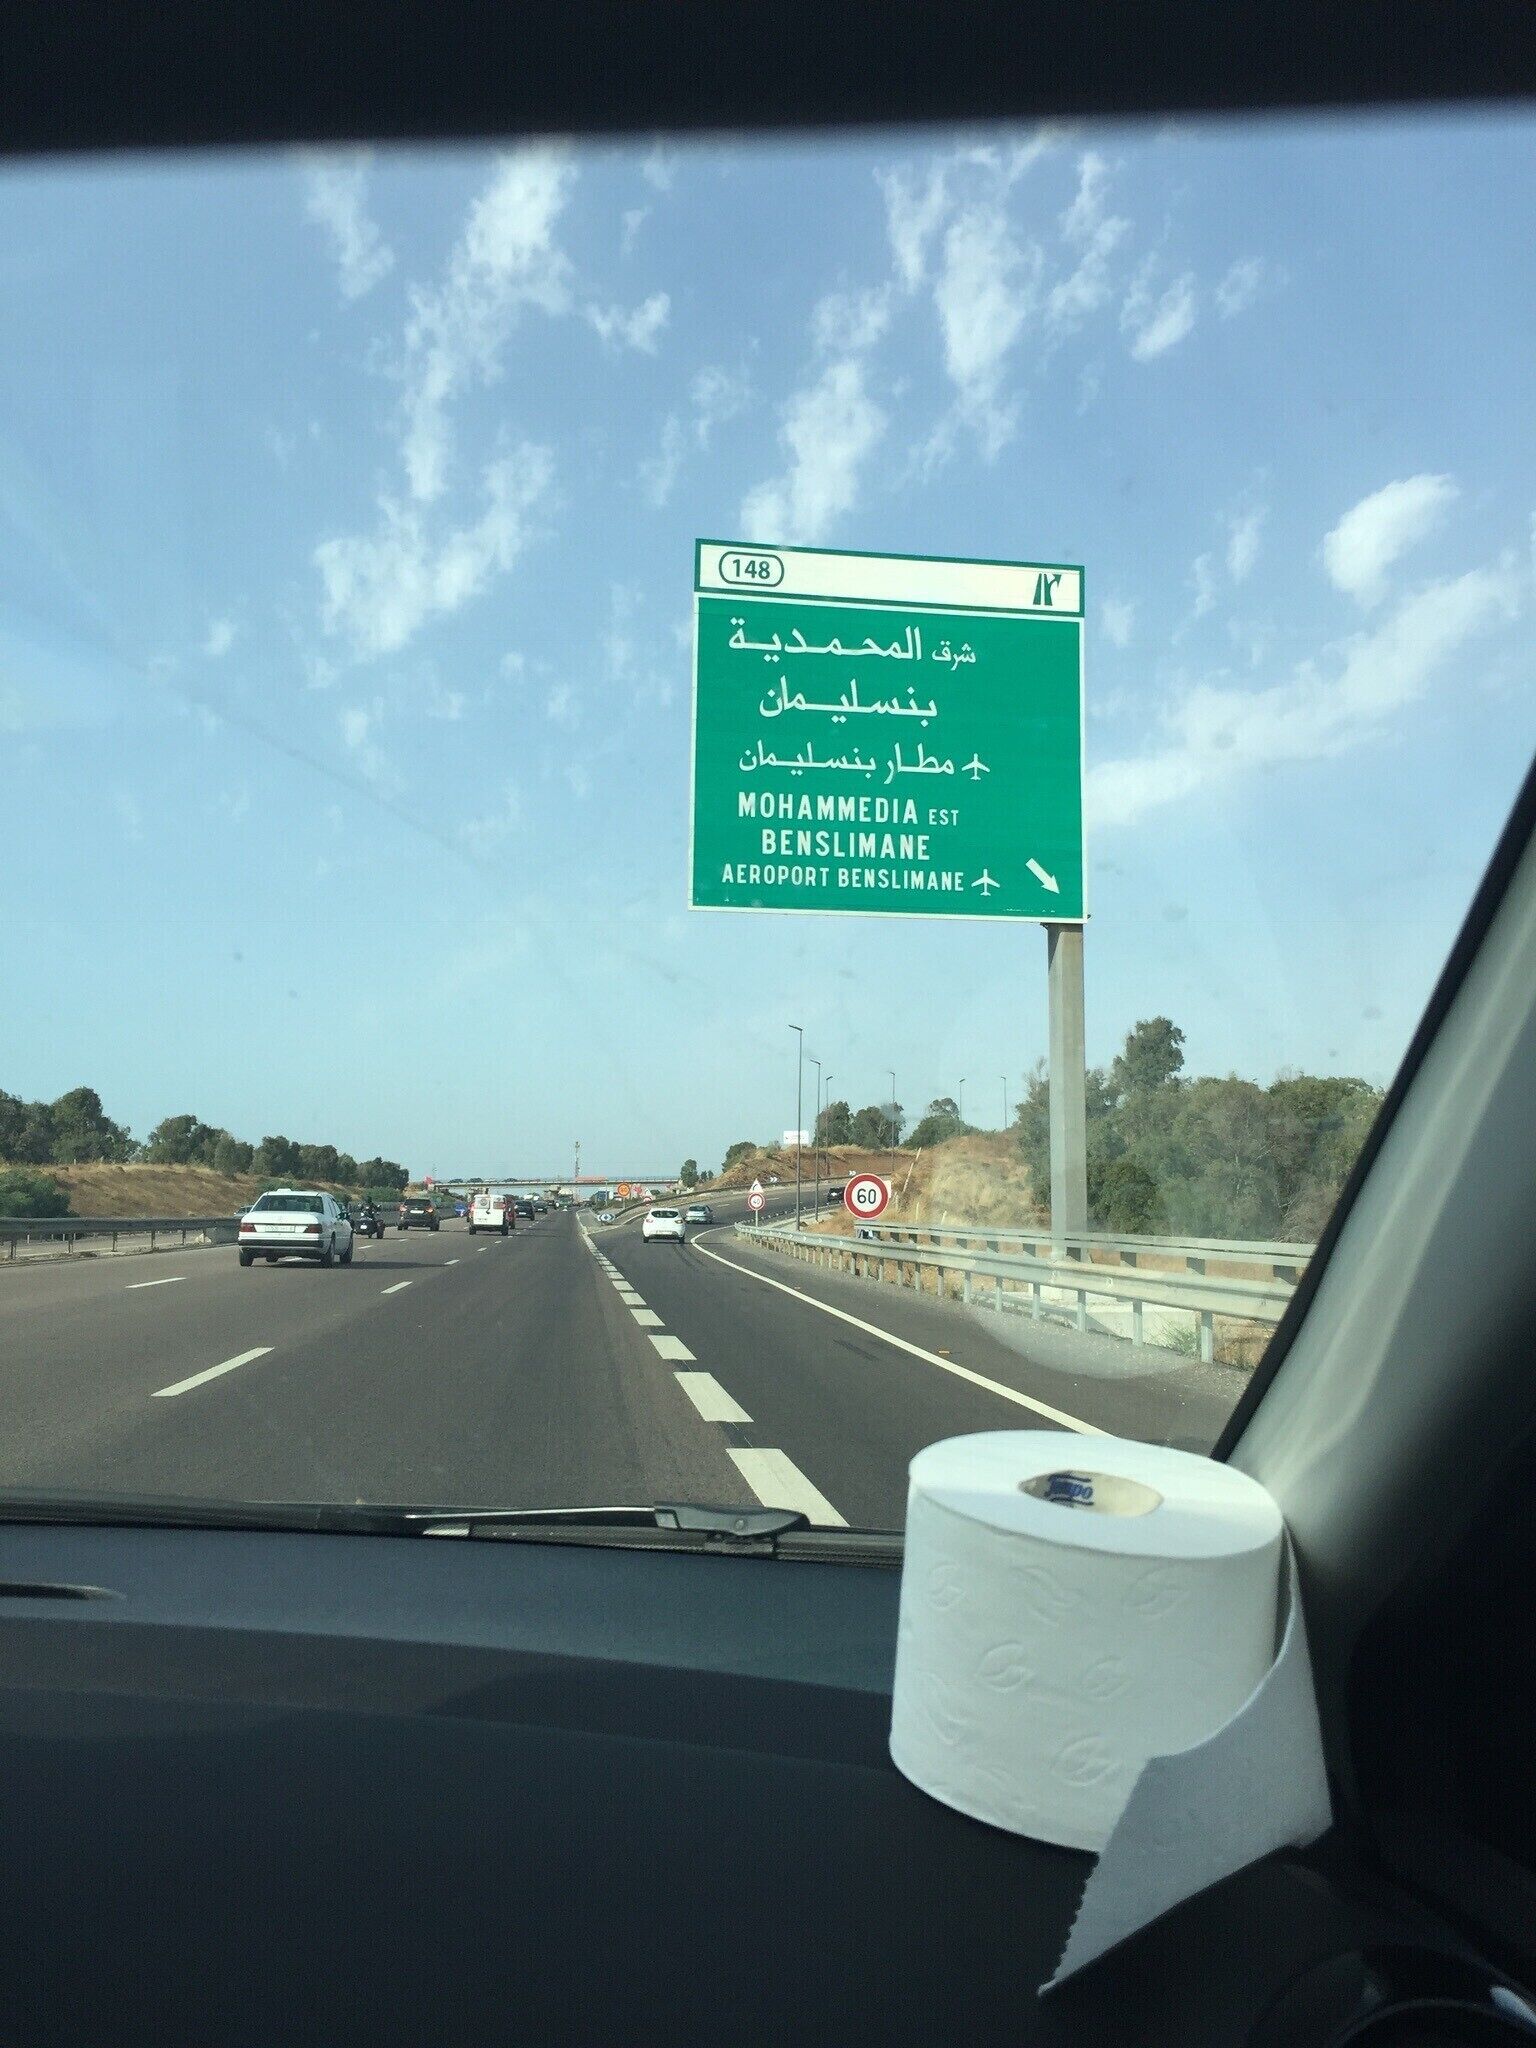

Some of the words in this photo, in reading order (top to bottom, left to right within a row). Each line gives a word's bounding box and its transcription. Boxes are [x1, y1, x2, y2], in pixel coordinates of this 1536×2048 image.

[732, 558, 770, 580] 148
[729, 618, 922, 662] المحمدية
[932, 641, 976, 670] شرق
[760, 676, 938, 727] بنسليمان
[739, 740, 877, 778] بنسليمان
[884, 743, 954, 784] مطار
[738, 791, 918, 824] MOHAMMEDIA
[929, 809, 959, 825] EST
[762, 829, 930, 860] BENSLIMANE
[722, 864, 829, 886] AEROPORT
[838, 868, 964, 890] BENSLIMANE
[857, 1188, 877, 1204] 60
